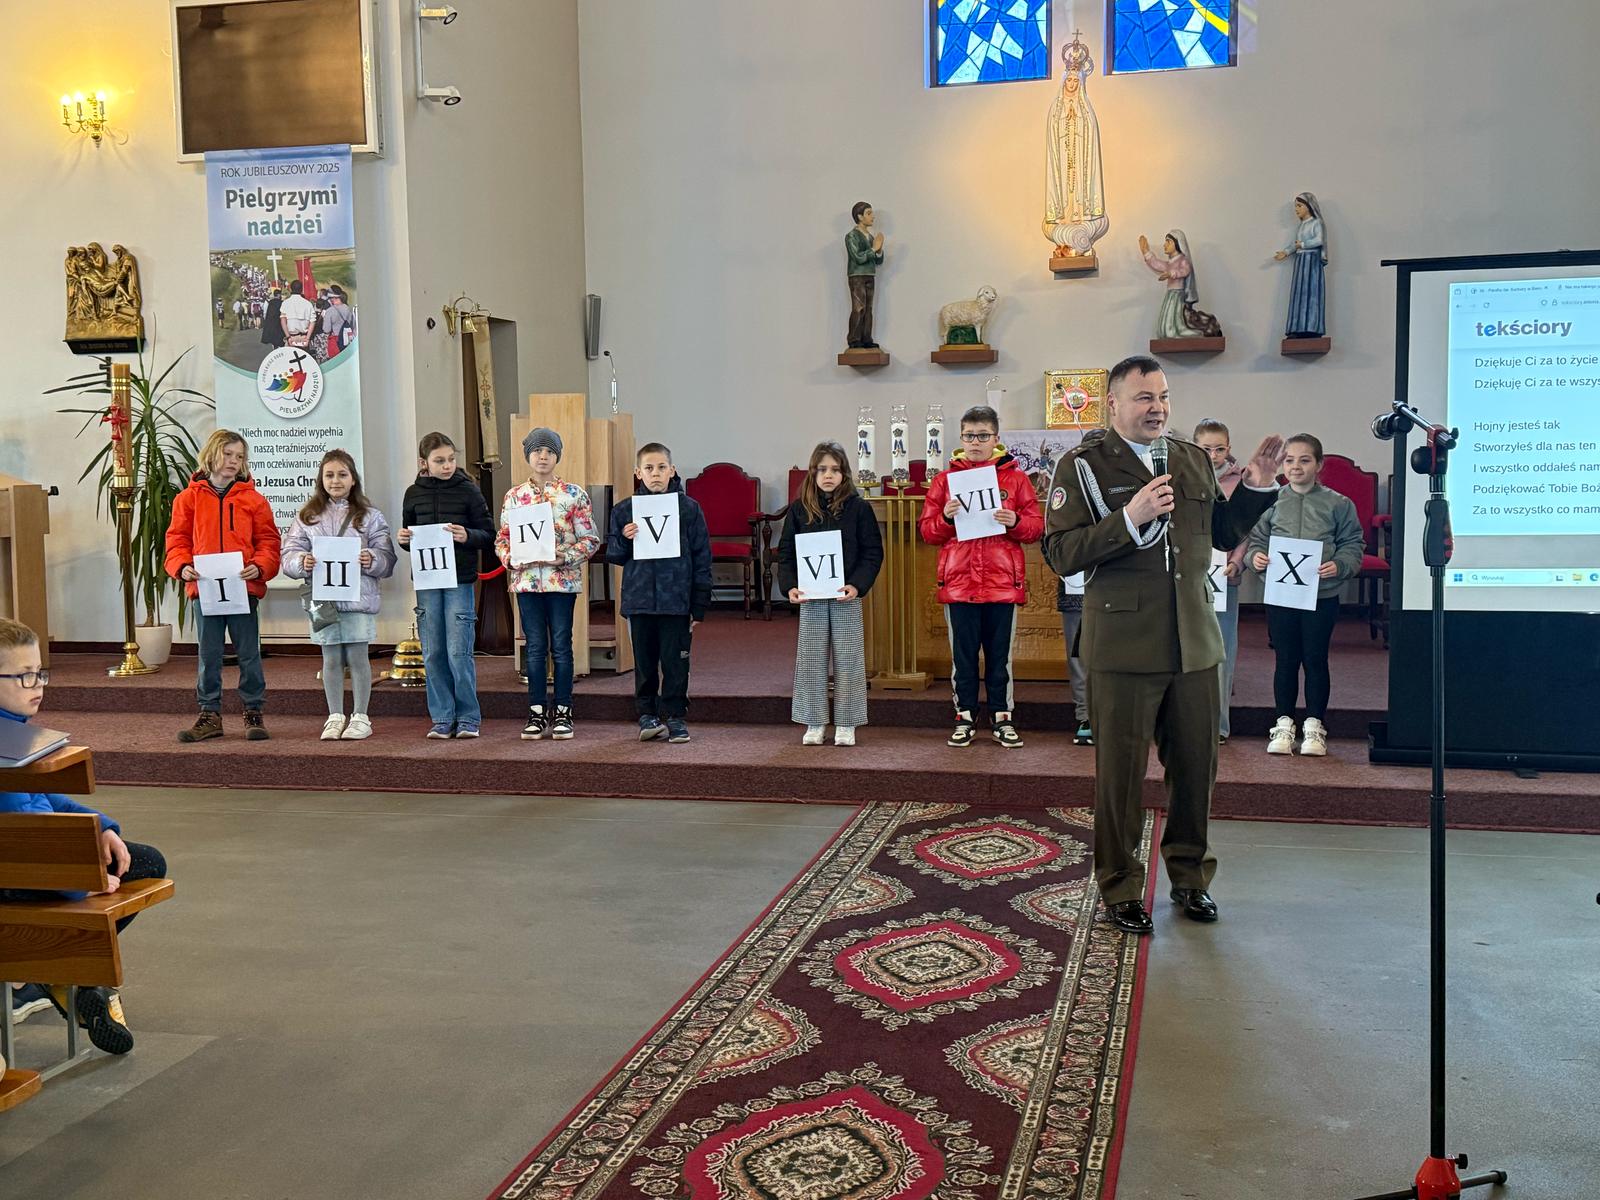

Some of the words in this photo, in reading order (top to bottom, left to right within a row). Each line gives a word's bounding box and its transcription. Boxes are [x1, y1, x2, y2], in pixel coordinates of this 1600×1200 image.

[220, 167, 240, 178] ROK
[243, 164, 315, 177] JUBILEUSZOWY
[317, 163, 340, 174] 2025
[225, 184, 338, 212] Pielgrzymi
[247, 213, 323, 236] nadziei
[1475, 319, 1573, 337] tekściory
[1525, 356, 1537, 366] Ci
[1540, 357, 1553, 366] za
[1556, 356, 1567, 365] to
[1570, 354, 1599, 367] życie
[1524, 377, 1537, 387] Ci
[1540, 379, 1553, 387] za
[1556, 378, 1567, 386] te
[279, 397, 313, 414] PIELGRZYMI
[311, 371, 320, 398] NADZIEI
[263, 429, 279, 437] moc
[280, 427, 307, 437] nadziei
[308, 427, 343, 439] wypełnia
[1474, 421, 1506, 433] Hojny
[1508, 420, 1541, 432] jesteś
[1544, 420, 1561, 430] tak
[254, 445, 275, 455] naszą
[1473, 441, 1533, 453] Stworzyłeś
[1536, 442, 1552, 451] dla
[1556, 442, 1576, 451] nas
[1579, 442, 1596, 450] ten
[266, 459, 311, 469] oczekiwaniu
[1473, 463, 1477, 473] I
[1480, 463, 1530, 474] wszystko
[1533, 462, 1576, 472] oddałeś
[264, 476, 295, 487] Jezusa
[1473, 483, 1545, 495] Podziękować
[1548, 483, 1578, 493] Tobie
[286, 493, 305, 502] niech
[954, 487, 998, 513] VII
[1472, 505, 1487, 515] Za
[1490, 506, 1501, 515] to
[1503, 505, 1554, 516] wszystko
[1557, 506, 1570, 514] co
[517, 520, 545, 543] IV
[641, 514, 671, 544] V
[416, 546, 449, 571] III
[322, 560, 351, 587] II
[801, 553, 839, 581] VI
[1275, 550, 1313, 586] X
[214, 577, 231, 603] I
